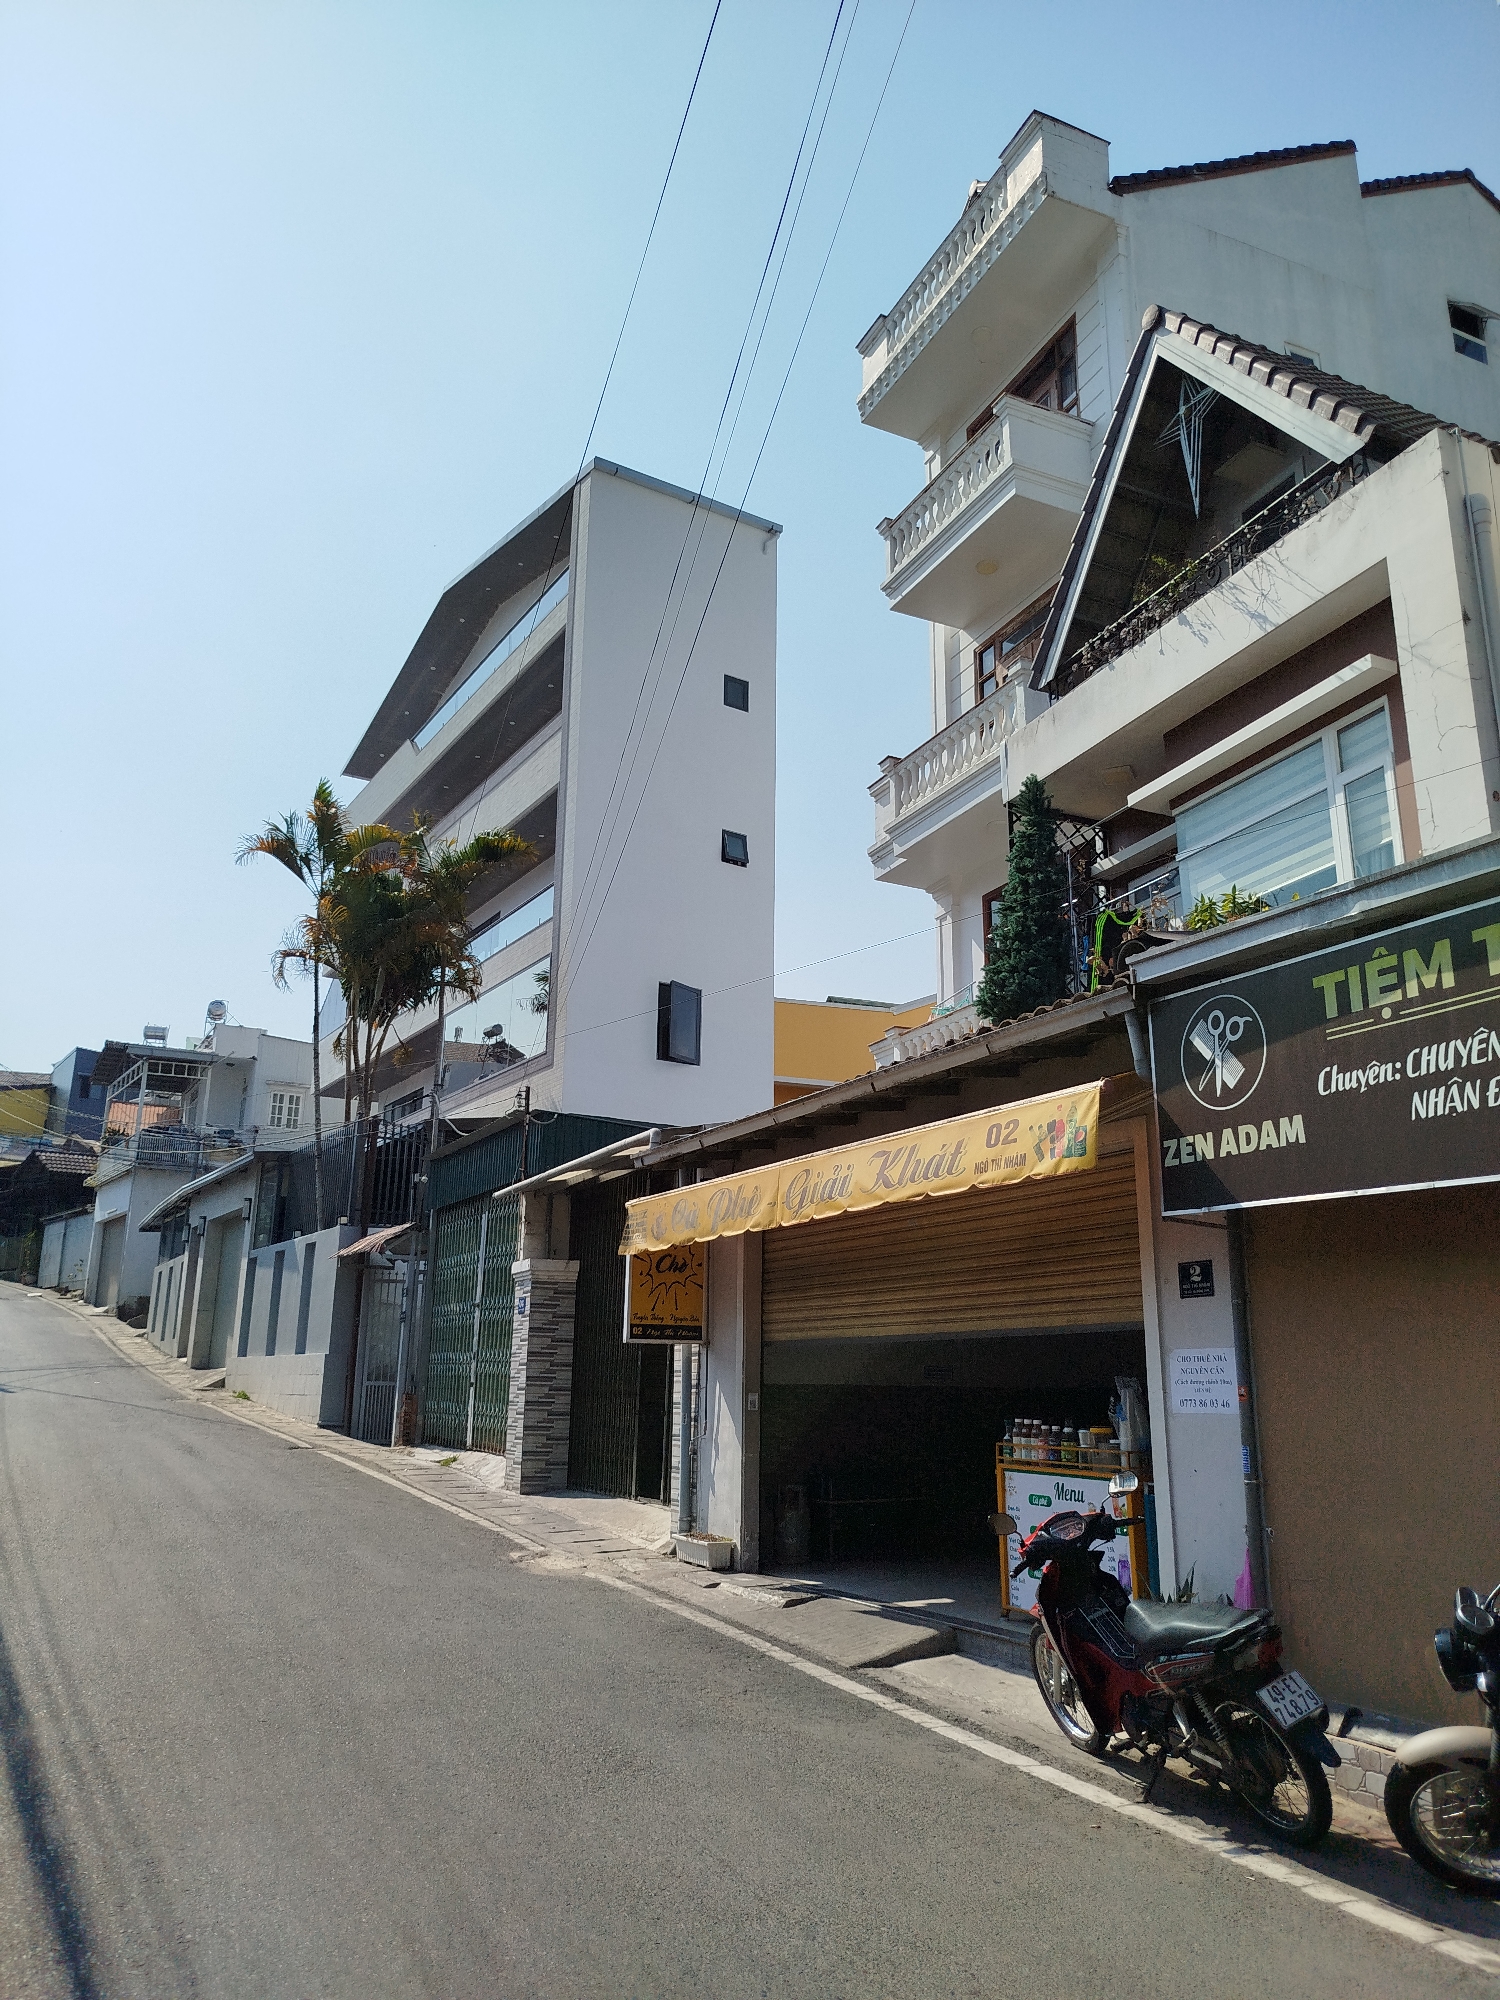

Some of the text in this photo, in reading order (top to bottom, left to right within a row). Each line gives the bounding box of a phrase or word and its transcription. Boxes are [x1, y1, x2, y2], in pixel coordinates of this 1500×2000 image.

[1312, 938, 1456, 1020] TIỆM
[1411, 1076, 1481, 1121] NHẬN
[985, 1119, 1020, 1149] 02
[1163, 1113, 1306, 1167] ZEN ADAM
[974, 1157, 989, 1176] NGÔ
[1003, 1151, 1027, 1171] NHẬM
[707, 1184, 763, 1234] Phê
[783, 1163, 855, 1220] Giải
[859, 1136, 971, 1191] Khát
[1189, 1265, 1203, 1282] 2
[632, 1326, 643, 1335] 02
[1176, 1352, 1228, 1363] CHO THUÊ NHÀ
[1179, 1398, 1231, 1408] 0773 86 03 46
[1054, 1481, 1086, 1504] Menu
[1266, 1675, 1302, 1704] 49-E1
[1274, 1689, 1320, 1725] 748.79
